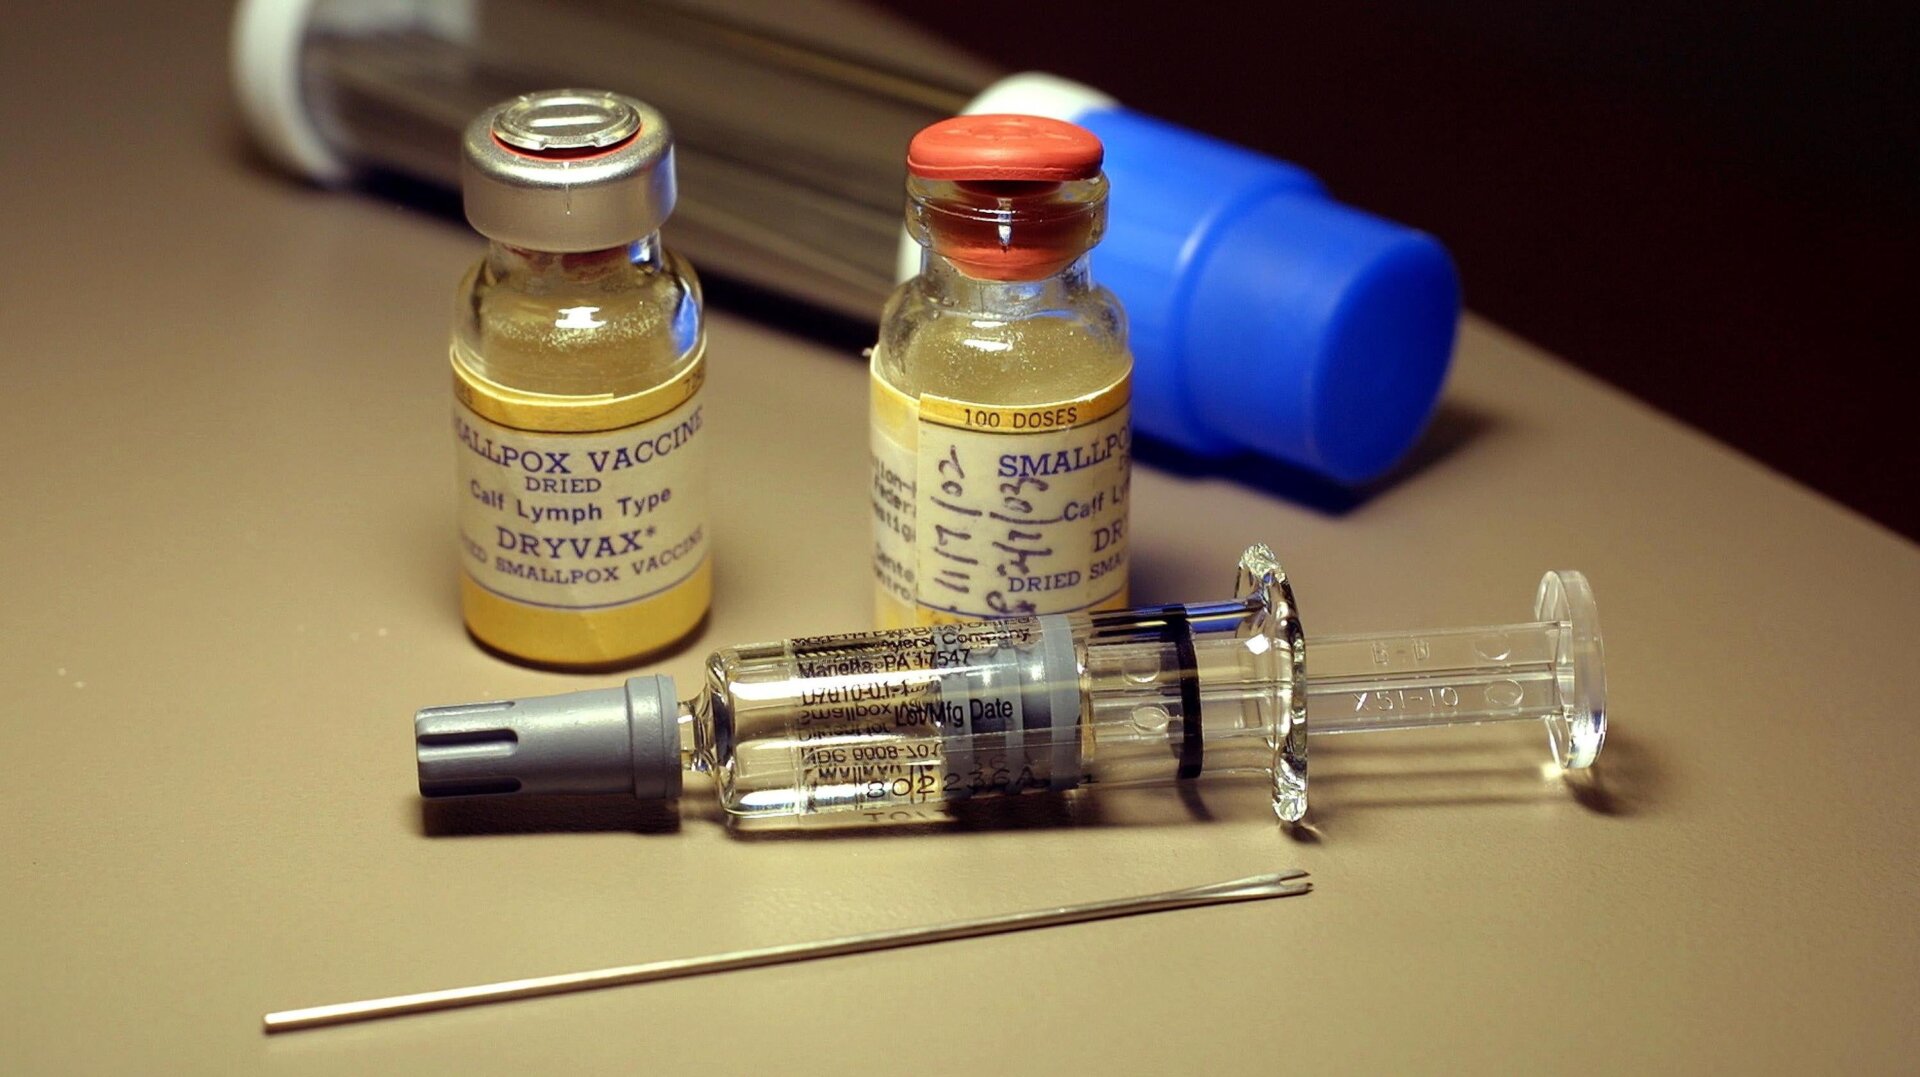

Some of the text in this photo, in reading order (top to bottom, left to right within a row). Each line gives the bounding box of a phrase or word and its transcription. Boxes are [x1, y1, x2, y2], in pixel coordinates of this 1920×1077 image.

[965, 407, 1077, 429] 100 DOSES
[526, 476, 602, 493] DRIED
[470, 479, 671, 525] Calf Lymph Type
[496, 556, 619, 584] SMALLPOX
[1007, 570, 1081, 592] DRIED
[941, 628, 1031, 644] Company
[883, 652, 912, 671] PA
[913, 648, 971, 669] 17547
[970, 697, 1014, 721] Date
